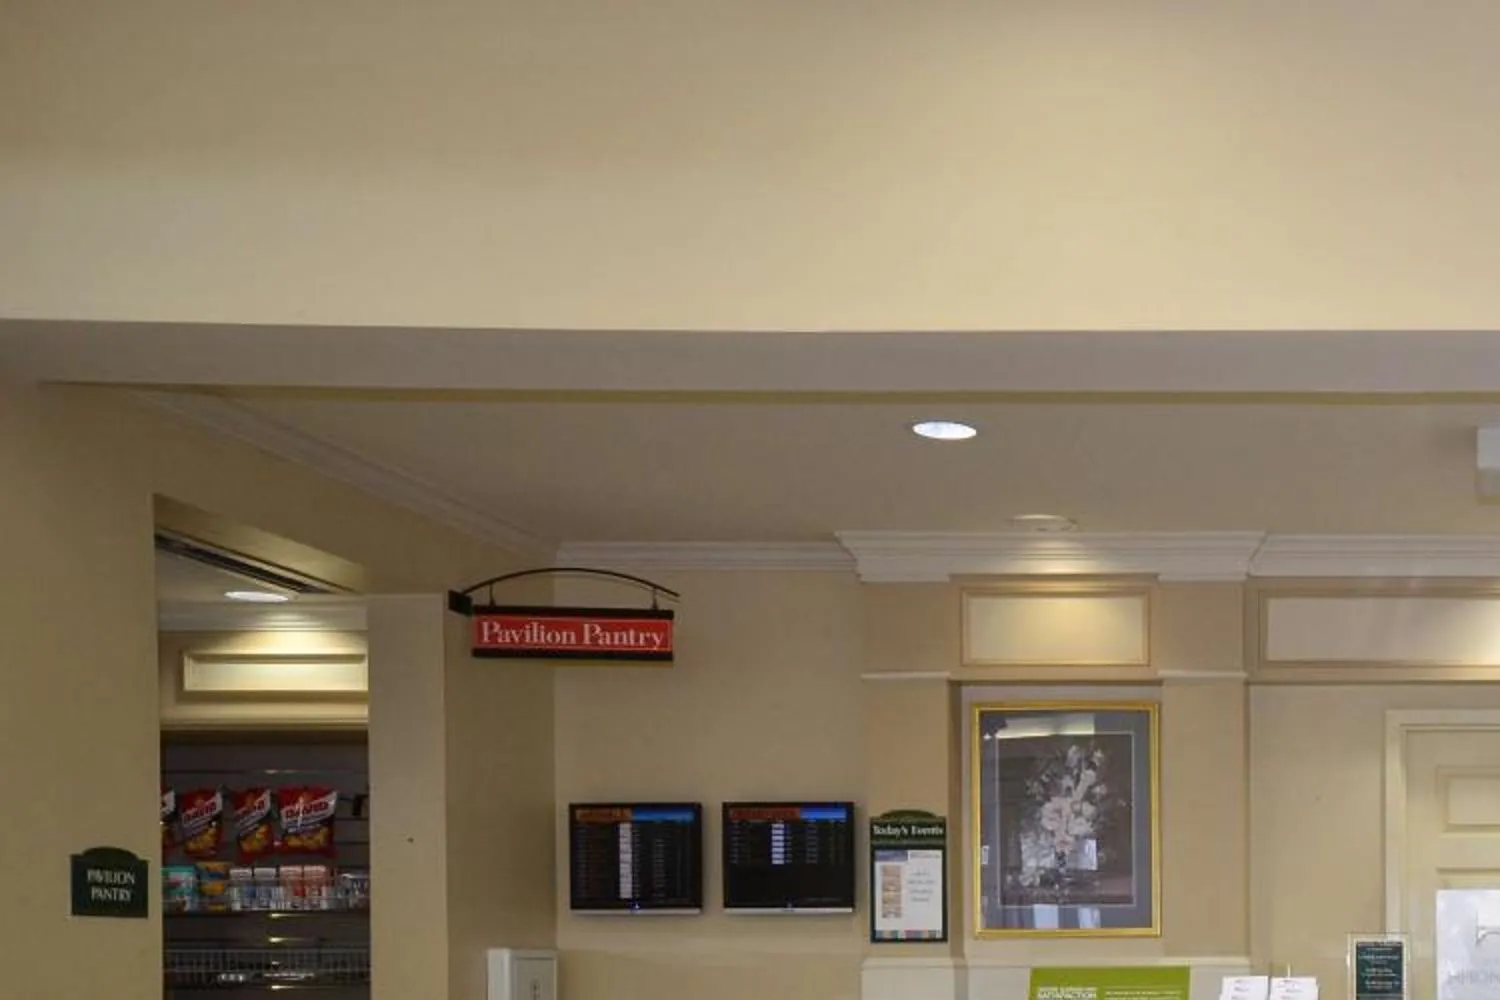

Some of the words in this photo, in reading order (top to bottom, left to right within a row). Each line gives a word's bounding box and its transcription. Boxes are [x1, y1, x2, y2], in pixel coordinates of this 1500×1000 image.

[481, 620, 577, 645] Pavilion
[582, 623, 665, 650] Pantry
[873, 823, 909, 838] Today's
[911, 825, 944, 836] Events
[91, 885, 132, 902] PANTRY
